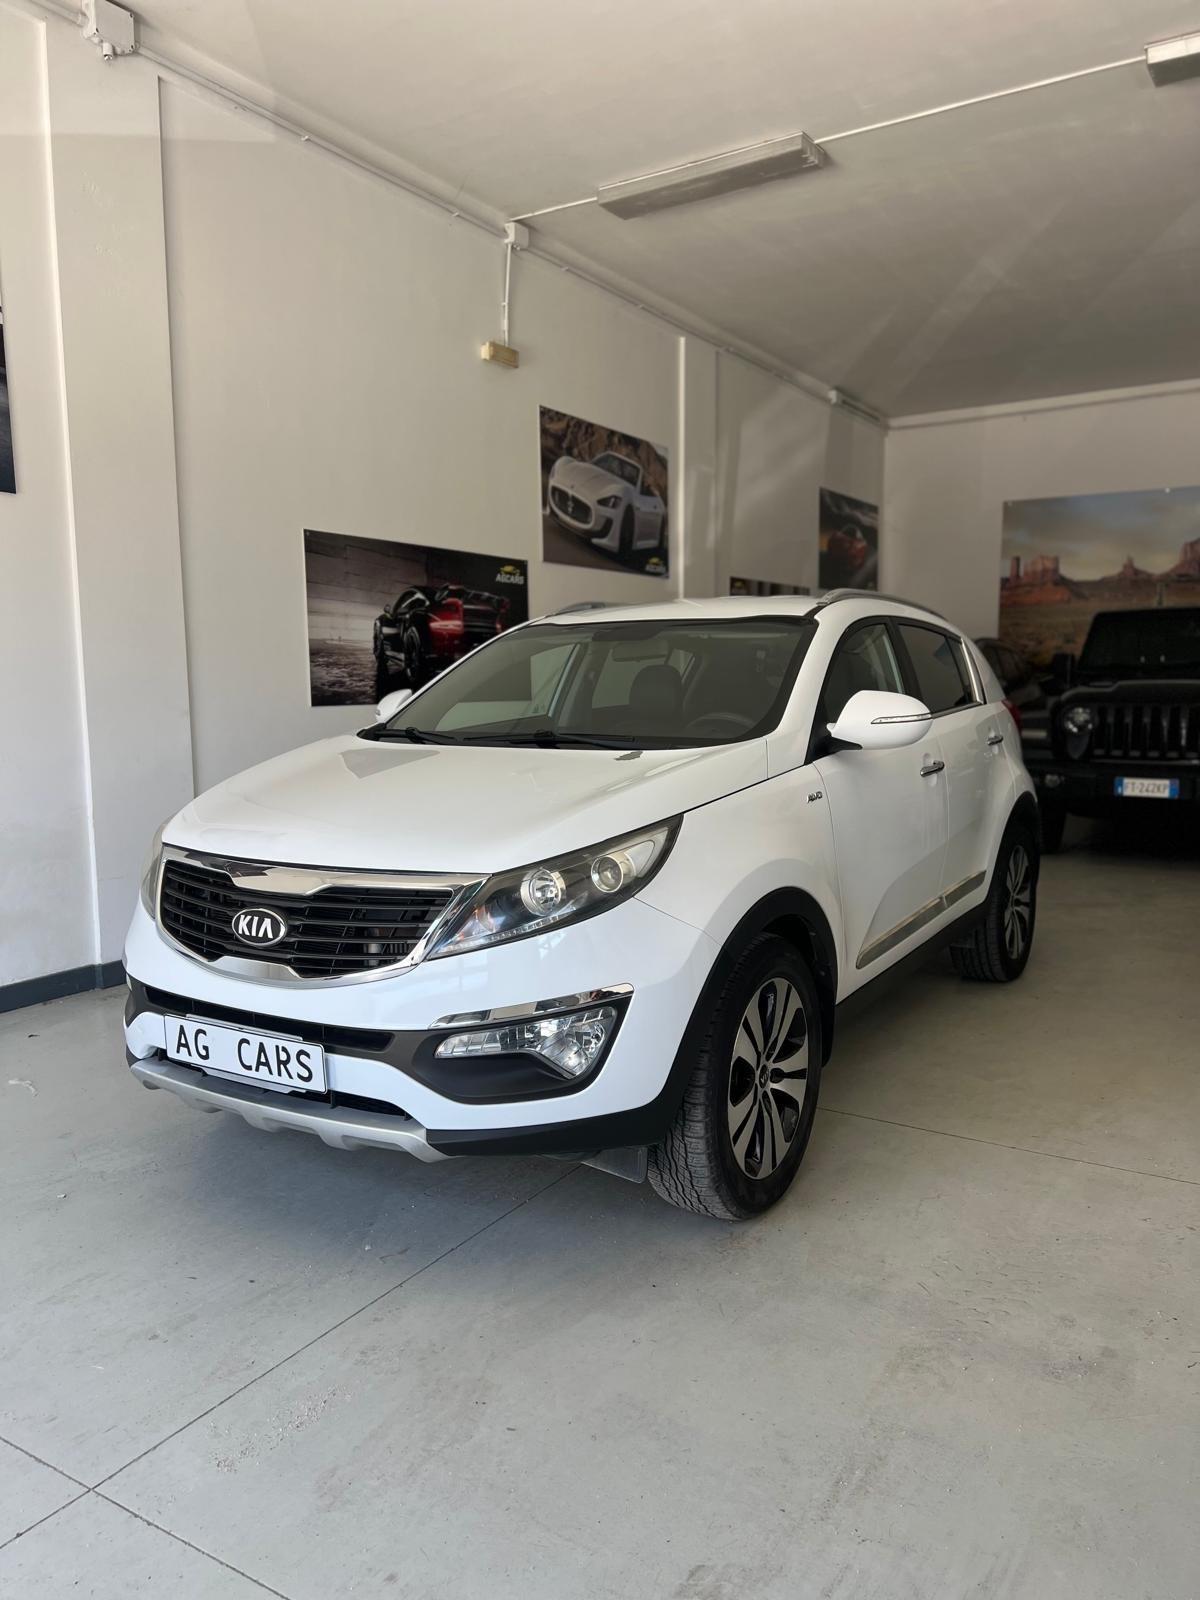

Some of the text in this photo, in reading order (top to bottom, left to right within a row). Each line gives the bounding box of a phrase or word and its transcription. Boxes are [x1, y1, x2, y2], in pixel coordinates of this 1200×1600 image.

[238, 914, 274, 939] KIA
[176, 1024, 313, 1083] AG CARS
